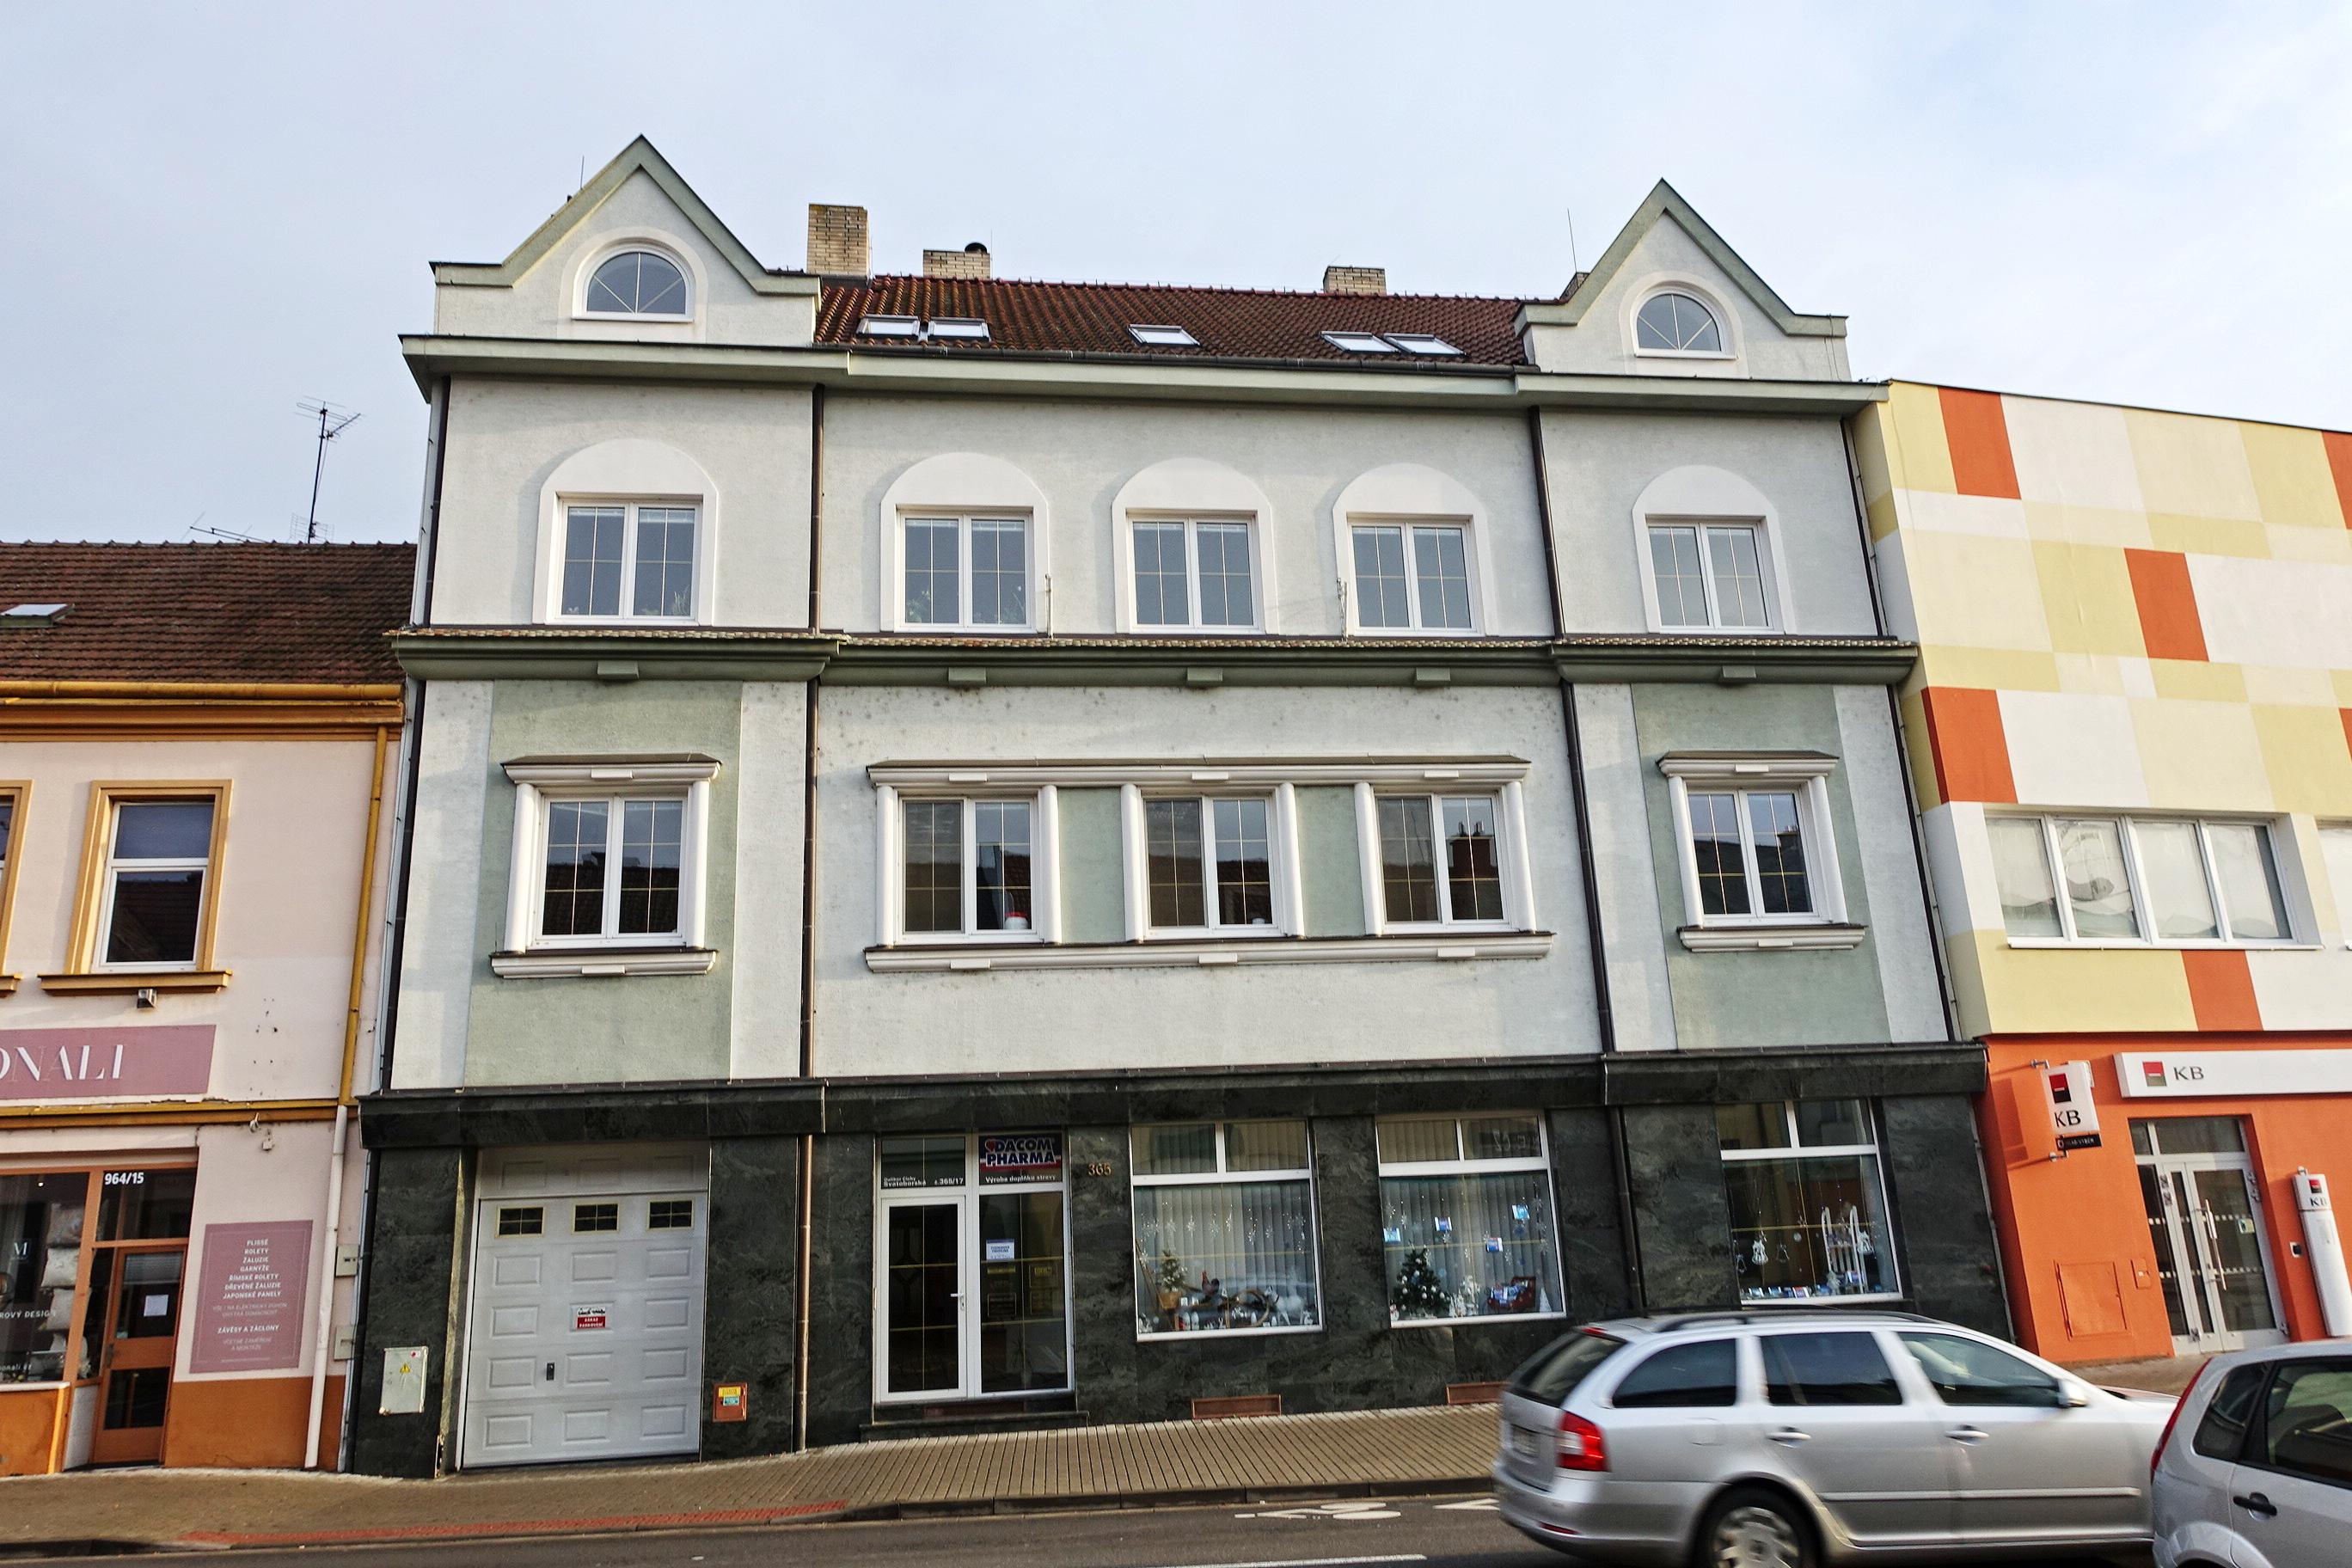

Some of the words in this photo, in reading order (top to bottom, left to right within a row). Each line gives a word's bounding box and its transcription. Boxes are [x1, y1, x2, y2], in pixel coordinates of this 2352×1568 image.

[0, 1044, 124, 1081] NALI
[2173, 1066, 2204, 1081] KB
[2054, 1110, 2081, 1128] KB
[993, 1138, 1053, 1153] DACOM
[986, 1152, 1057, 1167] PHARMA
[1087, 1162, 1112, 1176] 365
[104, 1172, 144, 1185] 964/15
[985, 1175, 1008, 1184] Výroba
[217, 1326, 242, 1334] ZÁVĚSY
[249, 1324, 279, 1332] ZÁCLONY
